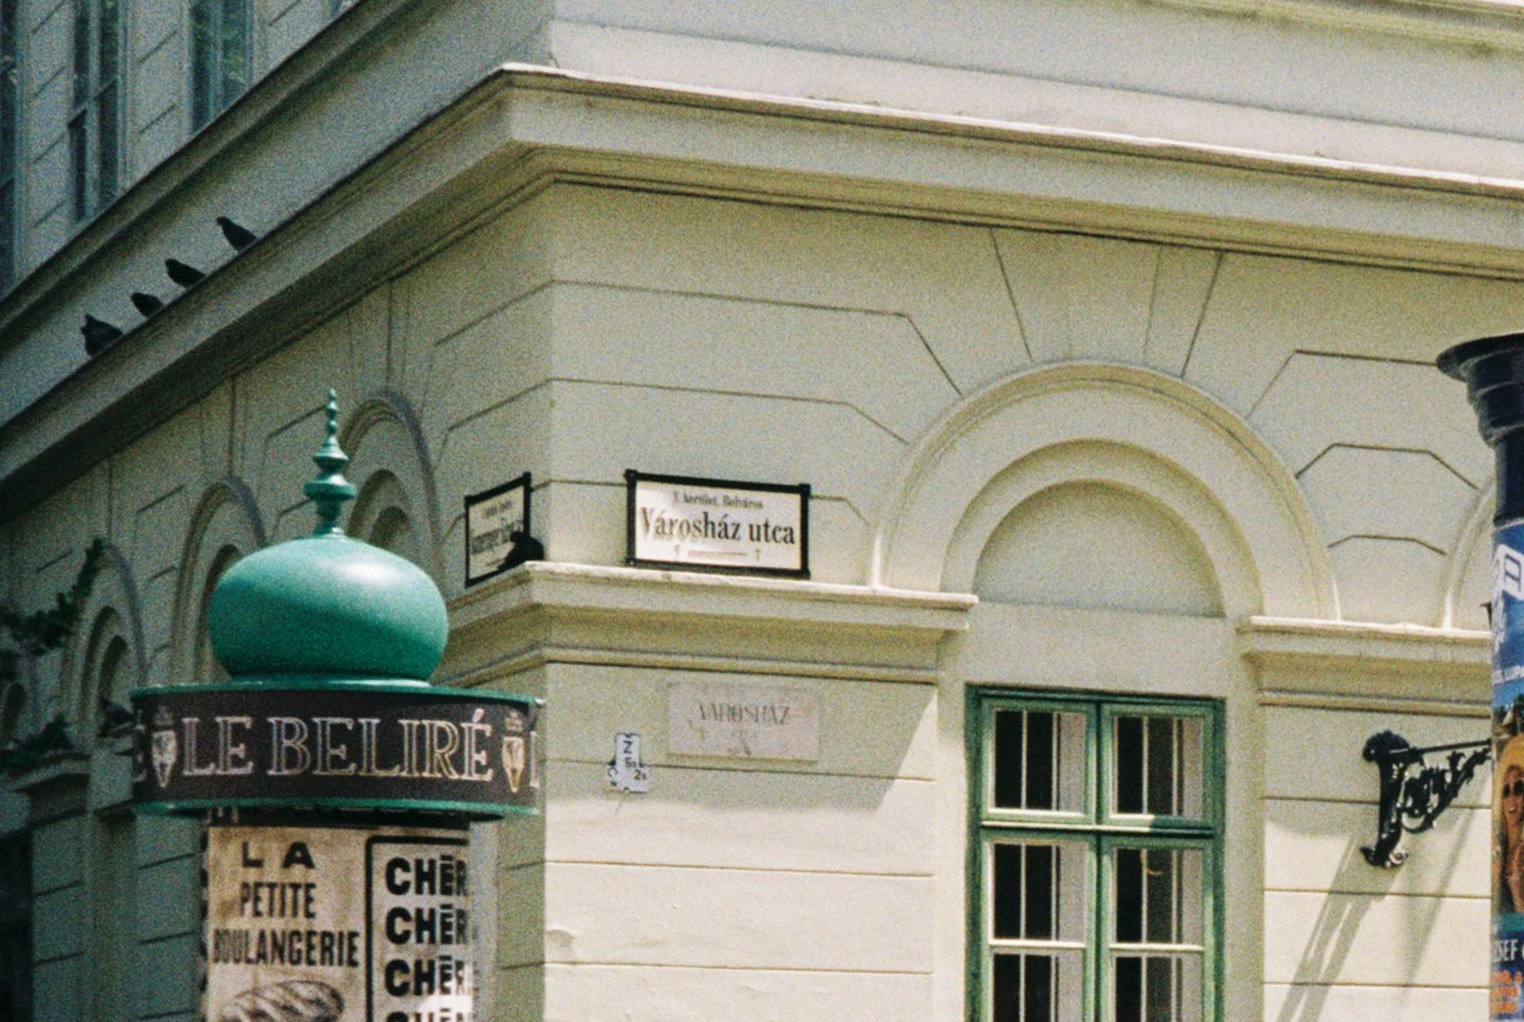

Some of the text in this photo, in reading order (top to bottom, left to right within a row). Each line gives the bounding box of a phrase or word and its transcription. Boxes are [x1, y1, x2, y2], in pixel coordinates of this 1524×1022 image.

[639, 507, 796, 545] Városház utca
[182, 715, 254, 777] LE
[266, 707, 494, 782] BELIRÉ
[240, 882, 317, 919] PETITE
[213, 928, 360, 967] BOULANGERIE
